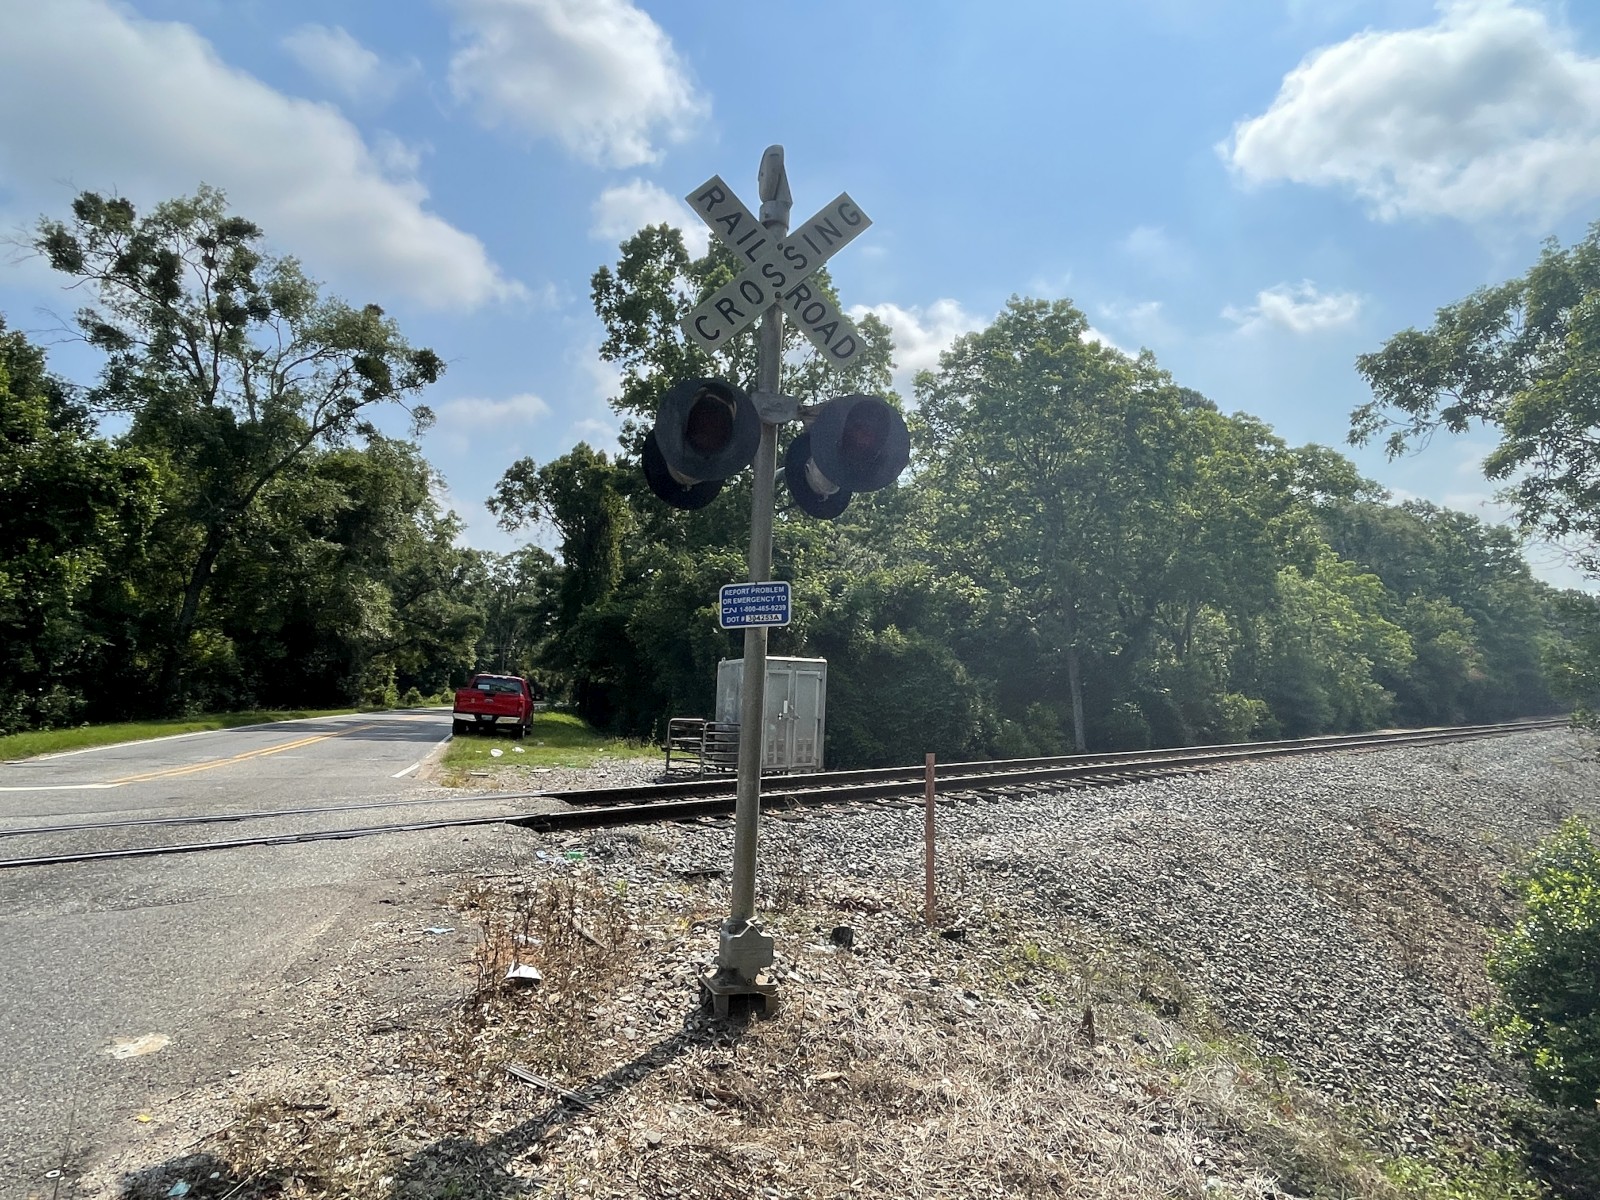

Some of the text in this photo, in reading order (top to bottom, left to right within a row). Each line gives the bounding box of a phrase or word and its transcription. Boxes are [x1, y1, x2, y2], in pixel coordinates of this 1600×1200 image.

[694, 202, 862, 341] CROSSING
[697, 185, 857, 360] RAIL ROAD
[725, 586, 785, 596] REPORT PROBLEM
[733, 595, 776, 604] EMERGENCY
